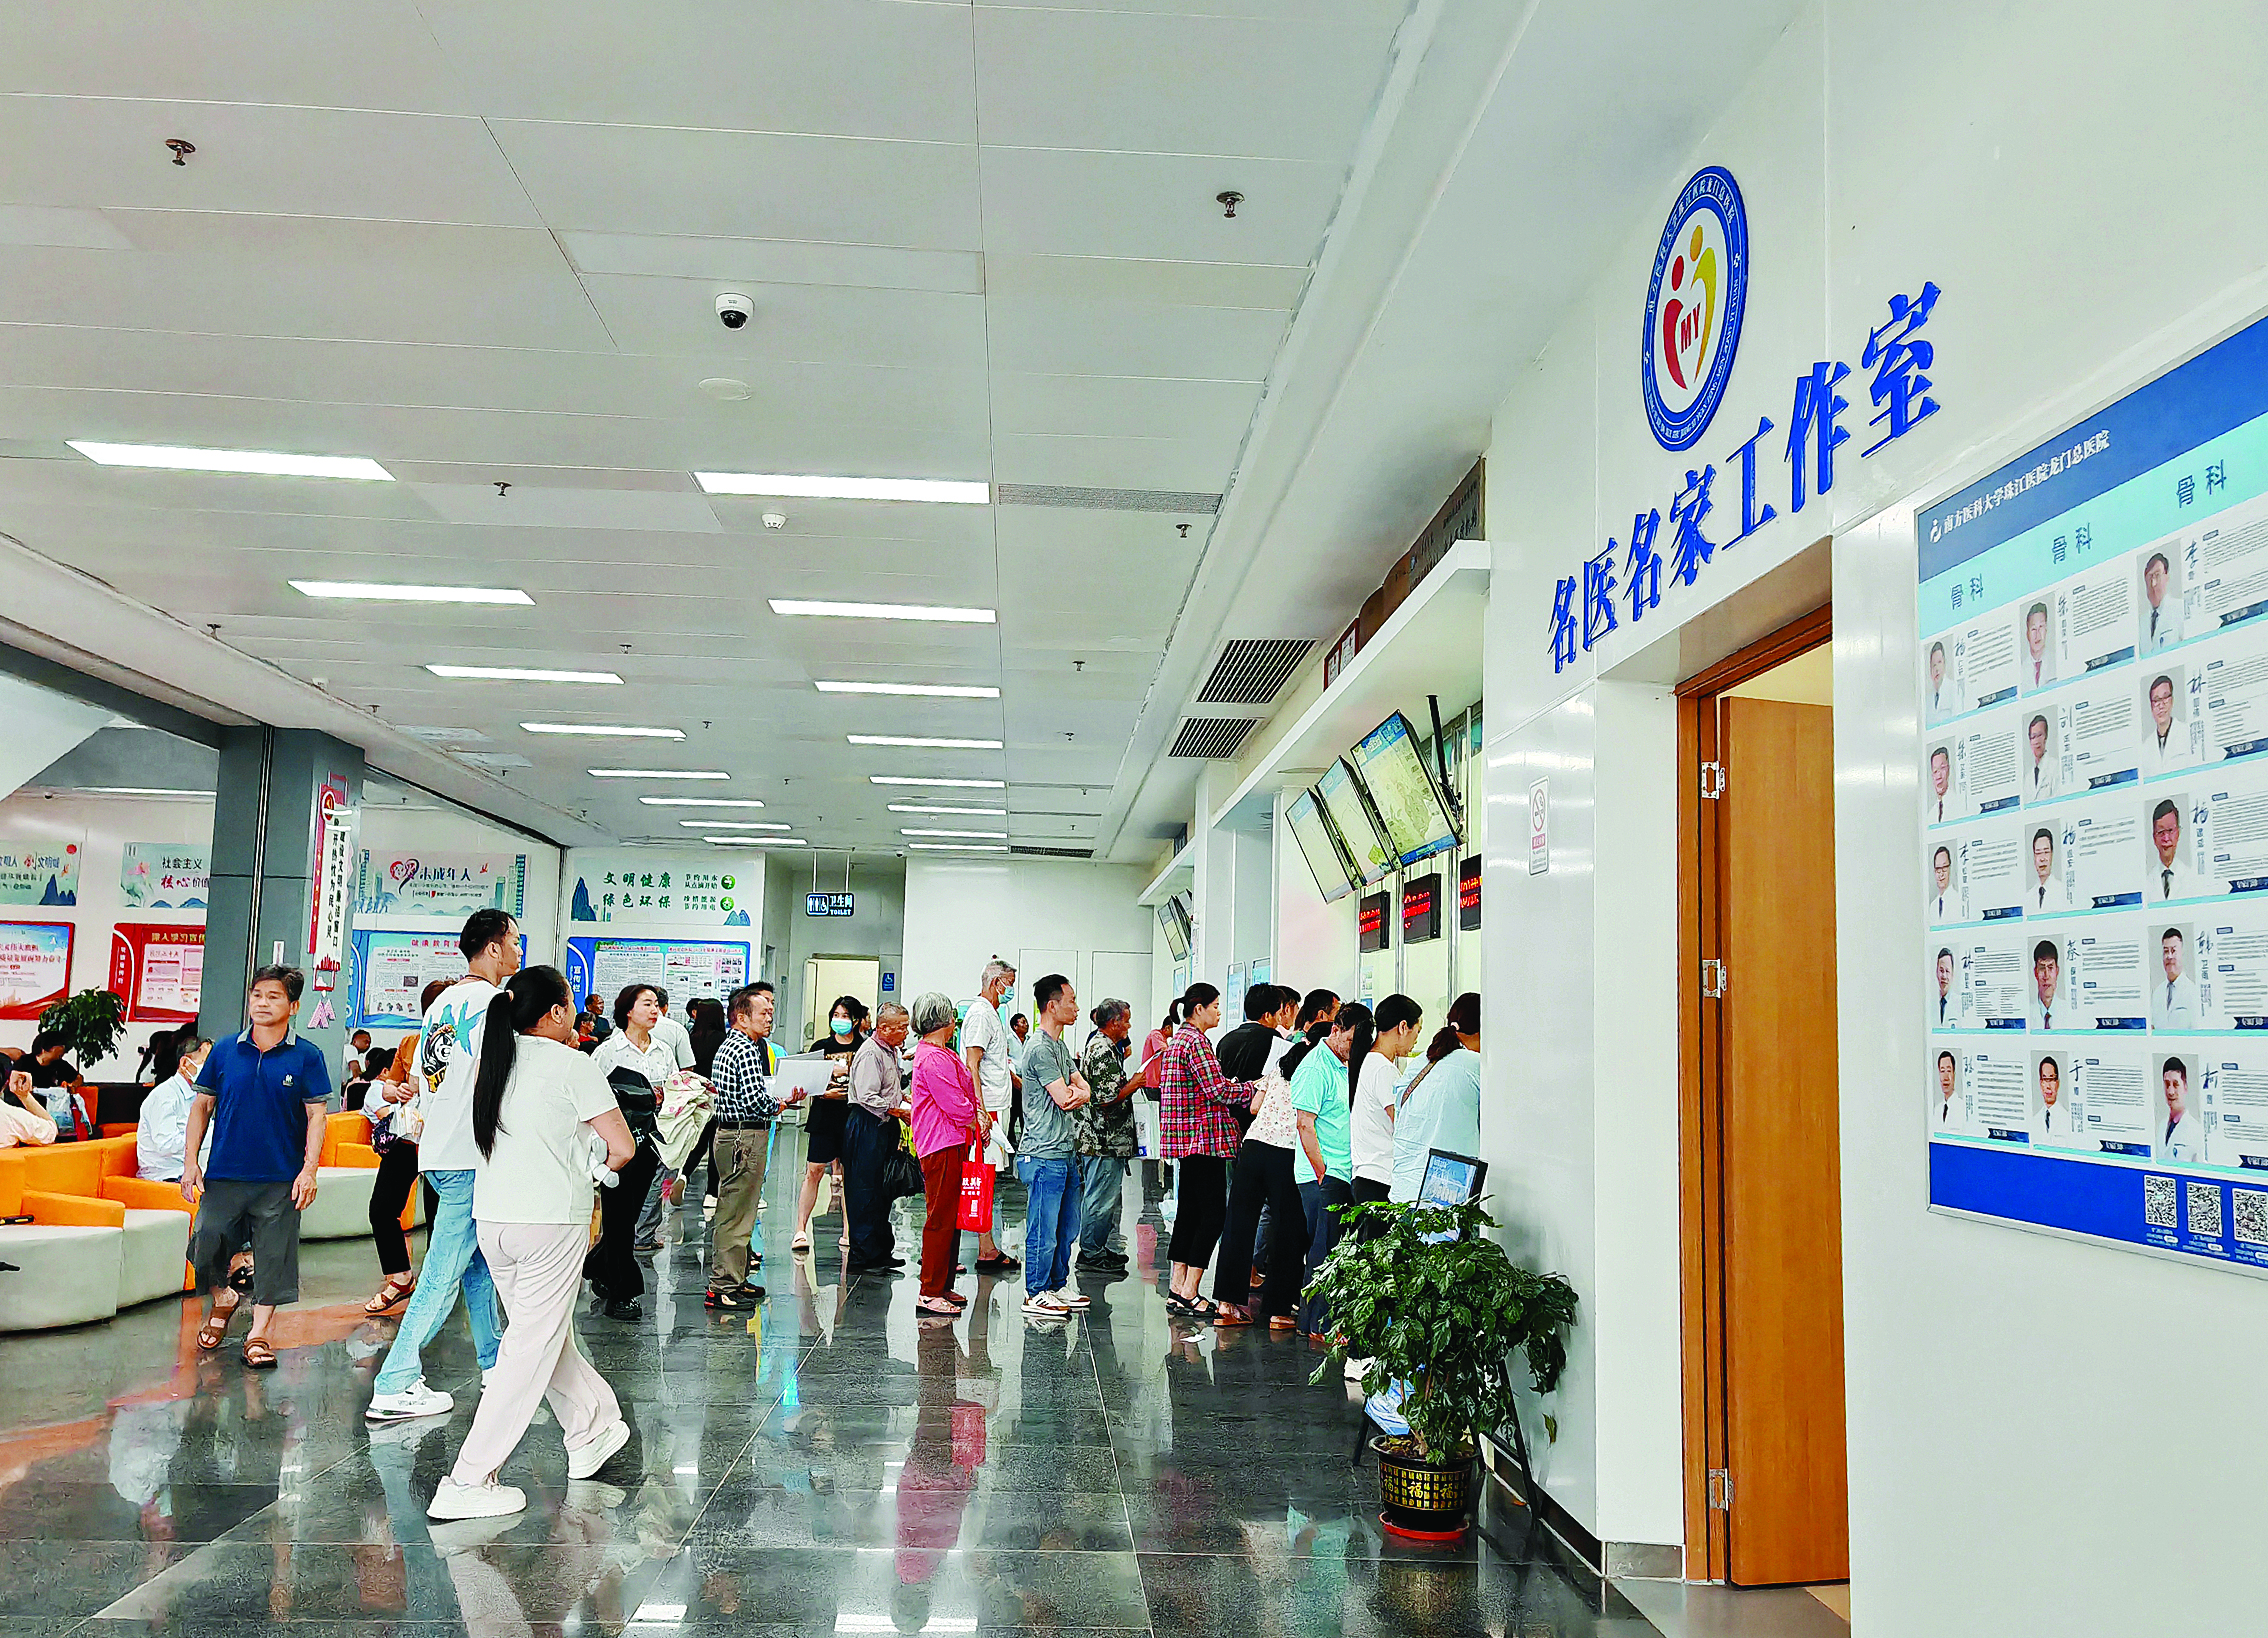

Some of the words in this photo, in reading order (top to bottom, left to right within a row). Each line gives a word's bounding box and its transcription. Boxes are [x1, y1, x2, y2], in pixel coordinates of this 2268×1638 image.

[1681, 302, 1701, 354] MY
[1548, 281, 1941, 674] 名医名家工作室
[1943, 428, 2111, 535] 南方医科大学珠江医院龙门总医院
[2176, 459, 2228, 509] 骨科
[2052, 523, 2092, 565] 骨科
[1951, 573, 1984, 610] 骨科
[162, 856, 202, 870] 社会主义
[603, 871, 671, 889] 文明健康
[602, 892, 671, 908] 绿色环保
[830, 894, 853, 908] 卫生间
[1407, 1481, 1423, 1498] 福
